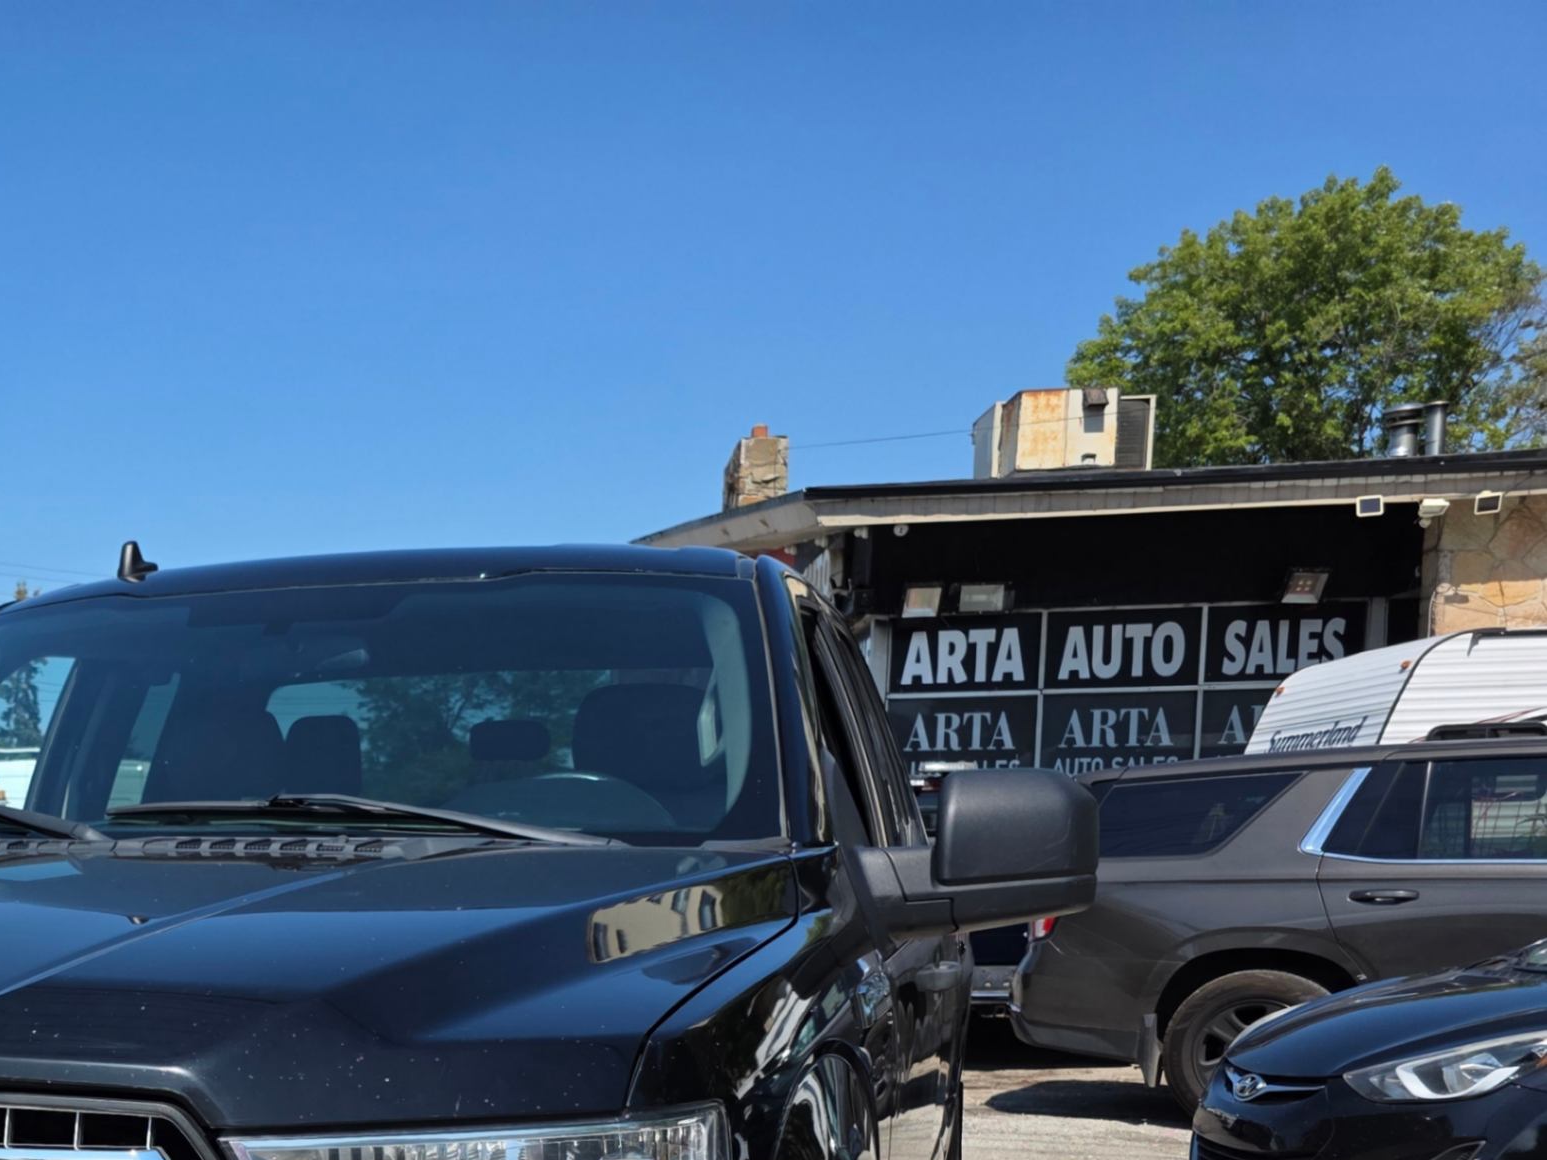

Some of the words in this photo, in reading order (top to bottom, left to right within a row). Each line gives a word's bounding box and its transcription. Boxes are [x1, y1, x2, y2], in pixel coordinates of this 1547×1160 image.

[900, 627, 1026, 685] ARTA
[1057, 621, 1186, 680] AUTO
[1221, 617, 1346, 676] SALES
[903, 710, 1016, 752] ARTA
[1058, 706, 1174, 748] ARTA
[1268, 715, 1369, 753] Summerland
